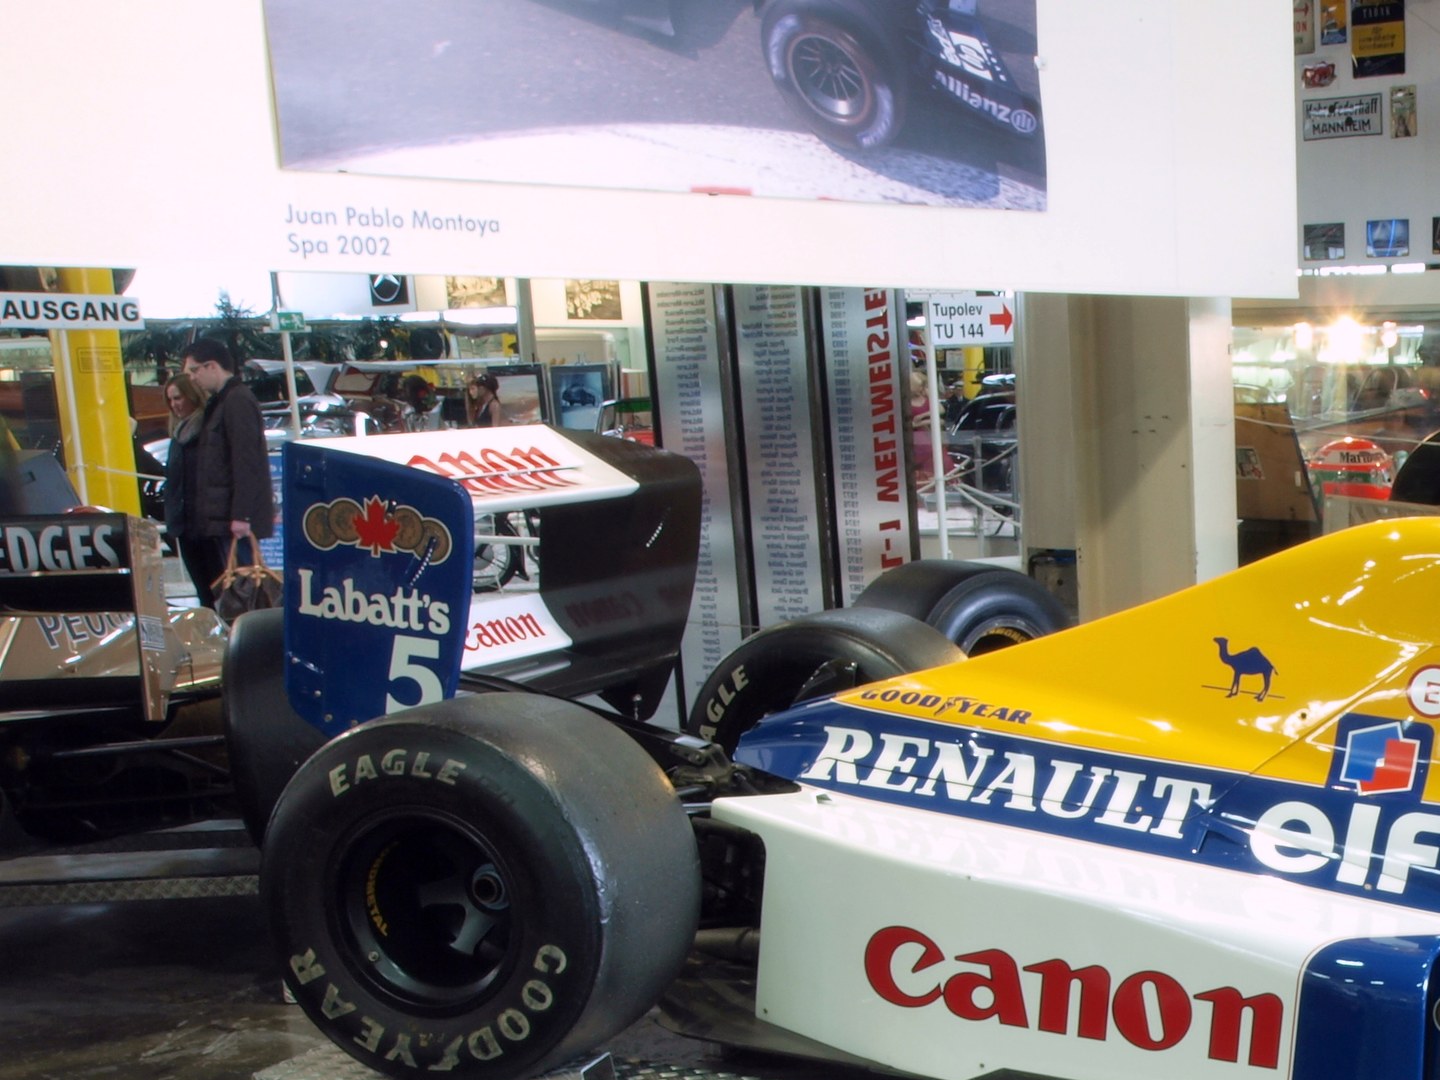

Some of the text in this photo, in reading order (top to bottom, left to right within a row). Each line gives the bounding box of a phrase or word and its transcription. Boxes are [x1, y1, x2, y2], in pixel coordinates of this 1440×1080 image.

[1312, 119, 1371, 135] MANNHEIM
[285, 203, 500, 235] Juan Pablo Montoya
[287, 234, 391, 259] Spa 2002
[3, 300, 140, 322] AUSGANG
[933, 303, 983, 319] Tupolev
[934, 323, 984, 339] TU 144
[407, 446, 581, 497] anon
[297, 568, 451, 635] Labatt's
[385, 634, 445, 715] 5
[328, 748, 468, 799] EAGLE
[801, 725, 1214, 840] RENAULT
[864, 924, 1284, 1070] Canon
